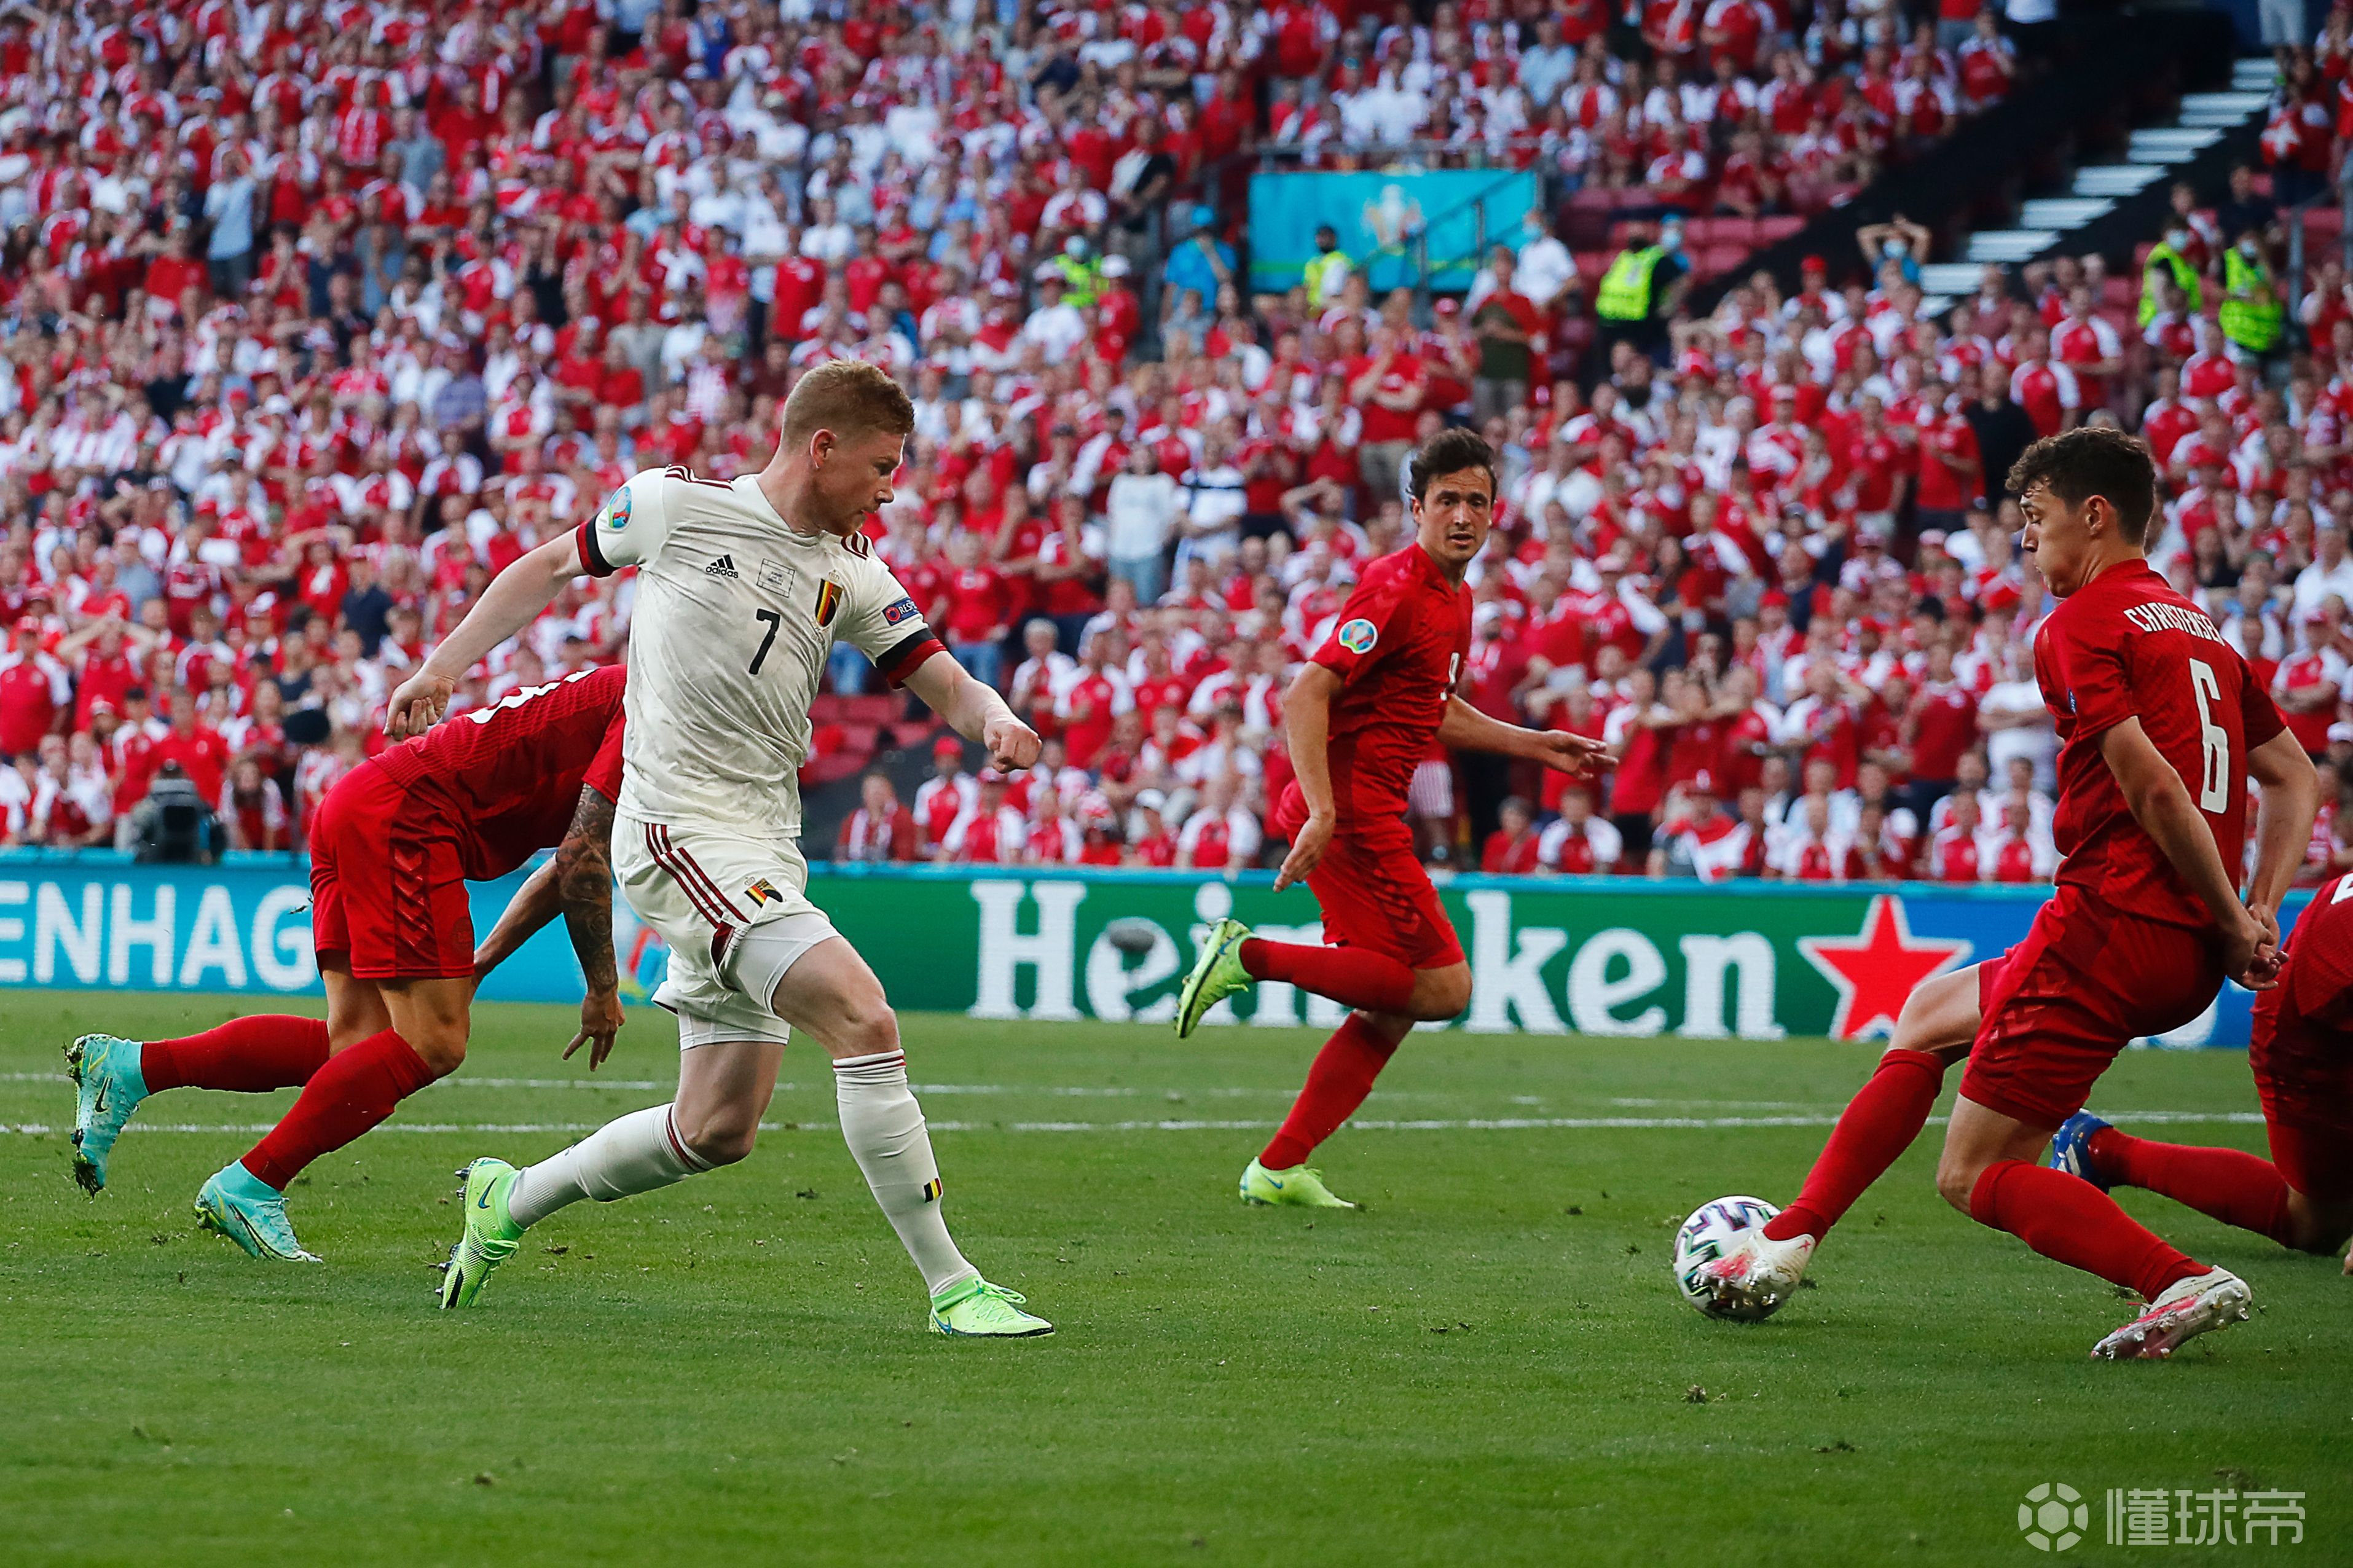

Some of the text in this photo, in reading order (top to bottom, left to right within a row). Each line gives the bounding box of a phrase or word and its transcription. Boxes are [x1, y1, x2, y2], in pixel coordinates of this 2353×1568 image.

[705, 566, 739, 579] adidas
[748, 608, 780, 675] 7
[2190, 657, 2229, 814] 6
